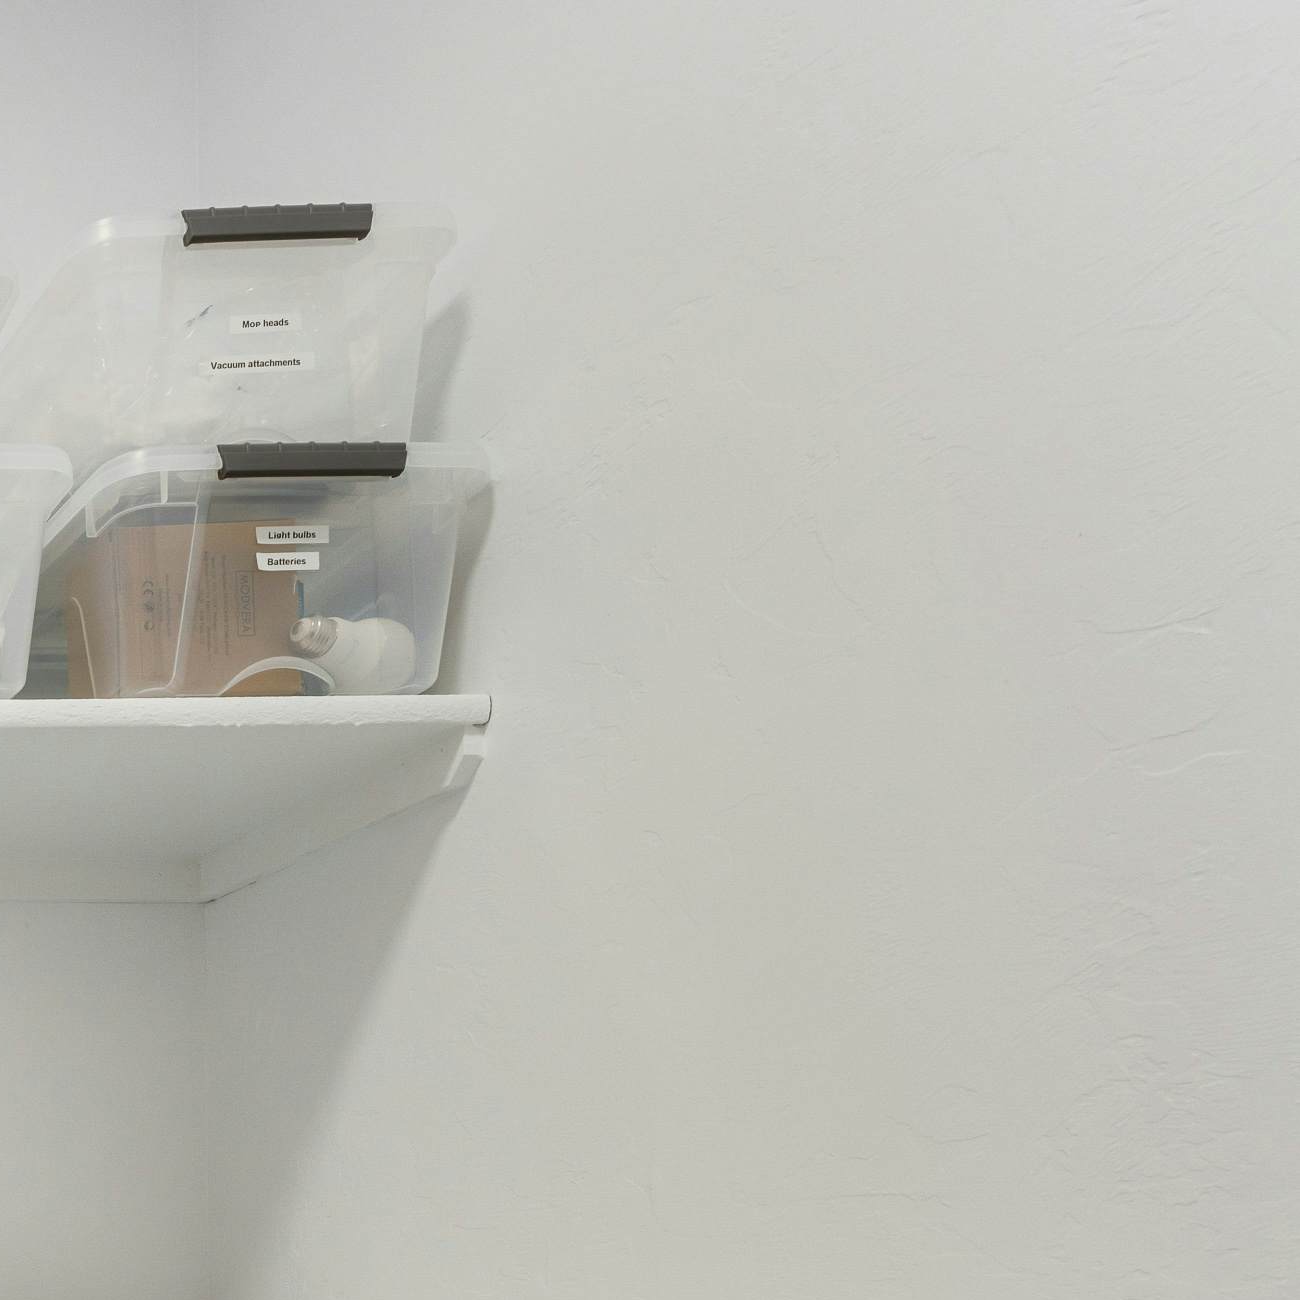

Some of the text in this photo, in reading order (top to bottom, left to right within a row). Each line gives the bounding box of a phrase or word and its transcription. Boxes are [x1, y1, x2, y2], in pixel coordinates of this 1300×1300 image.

[263, 318, 289, 327] heads
[211, 359, 300, 369] Vacuum attachments
[268, 531, 290, 540] Light
[267, 558, 306, 566] Batteries
